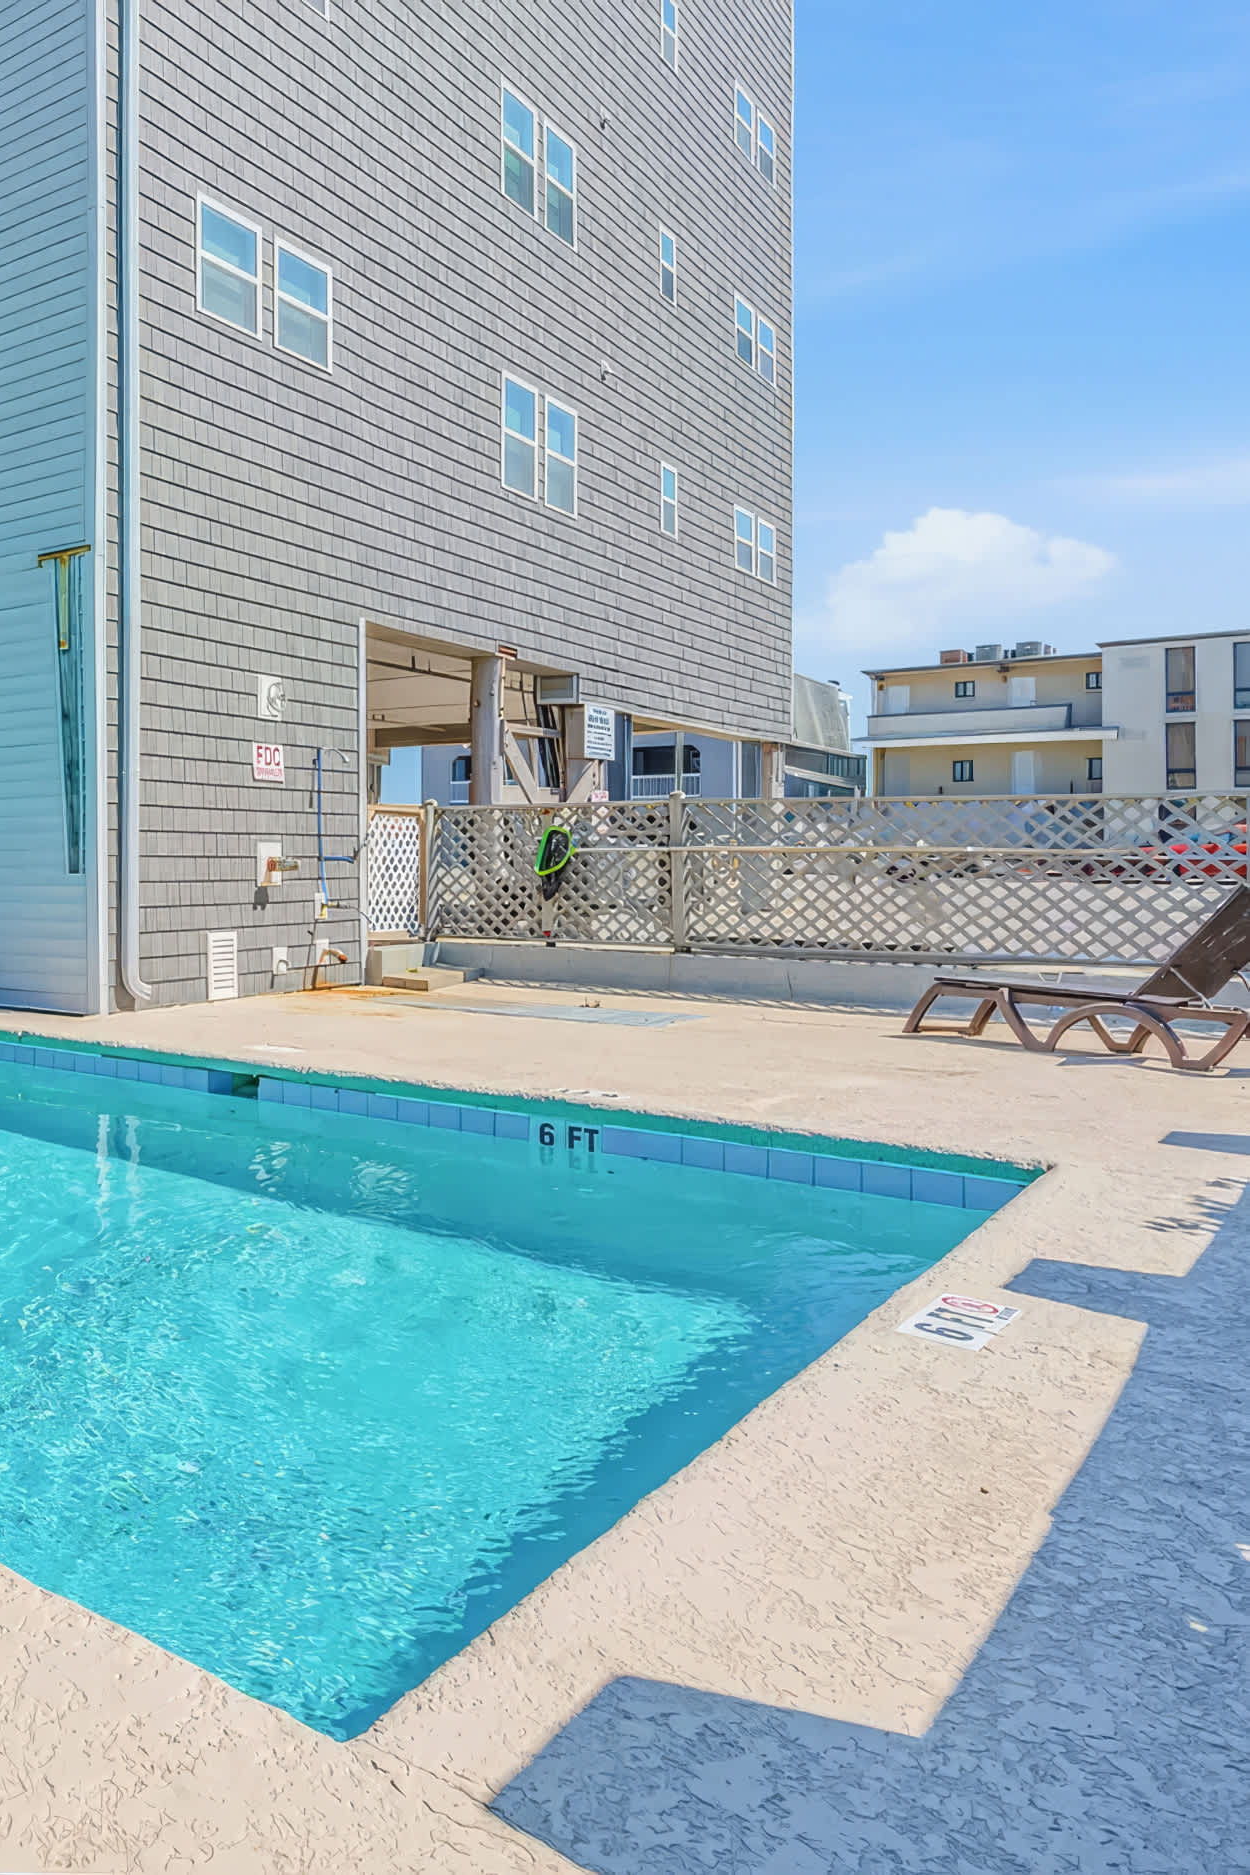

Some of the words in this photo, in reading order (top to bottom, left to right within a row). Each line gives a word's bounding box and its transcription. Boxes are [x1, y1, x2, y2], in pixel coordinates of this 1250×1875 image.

[538, 1122, 556, 1147] 6
[567, 1125, 599, 1153] FT
[926, 1306, 995, 1330] FT
[913, 1321, 975, 1342] 6
